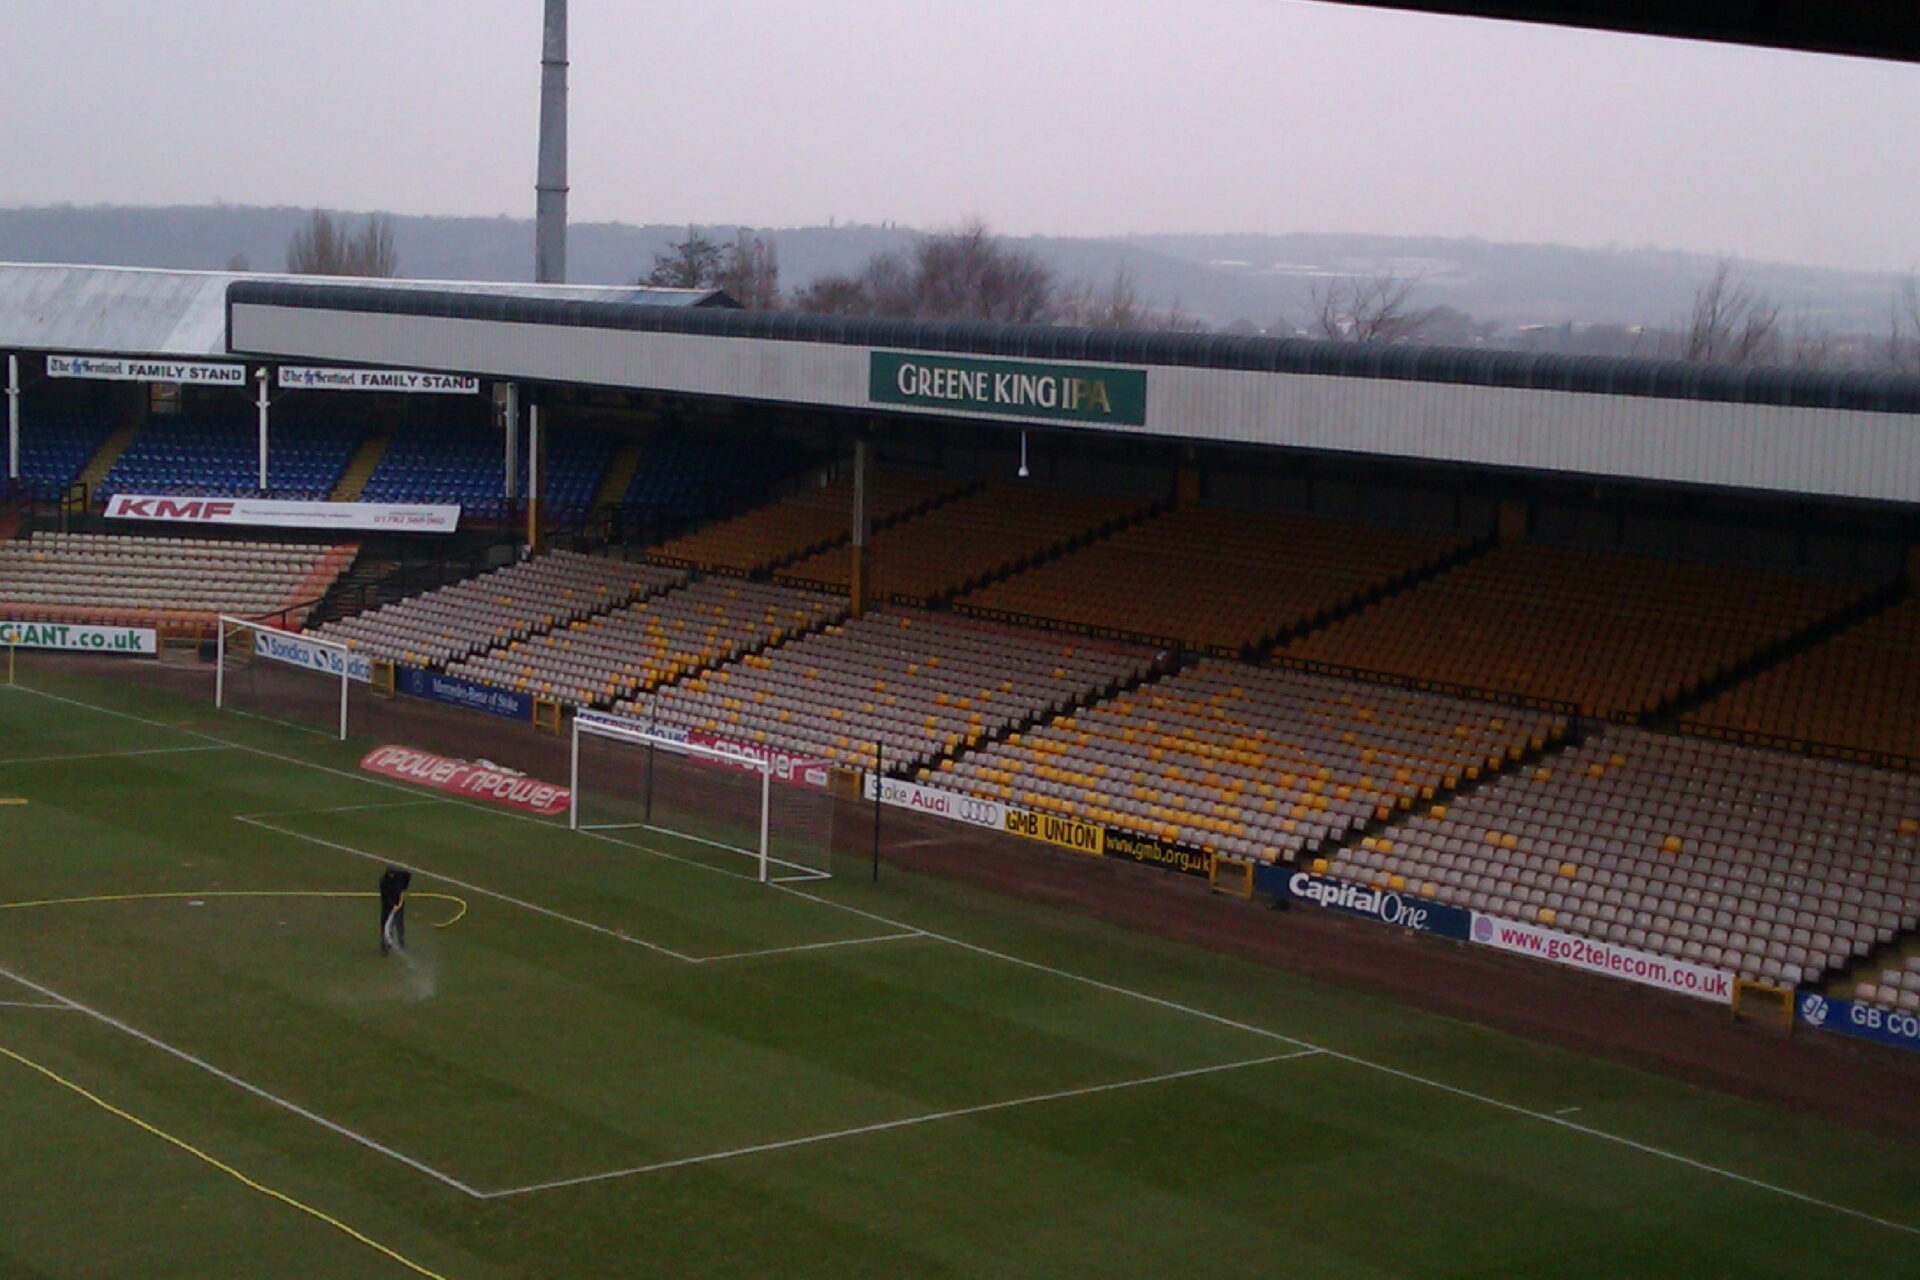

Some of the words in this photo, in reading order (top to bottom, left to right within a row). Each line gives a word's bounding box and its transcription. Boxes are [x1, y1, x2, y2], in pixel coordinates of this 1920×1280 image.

[128, 363, 185, 378] FAMILY
[189, 366, 242, 381] STAND
[361, 373, 418, 388] FAMILY
[422, 376, 475, 390] STAND
[897, 363, 988, 402] GREENE
[994, 372, 1057, 408] KING
[1062, 377, 1112, 414] IPA
[116, 498, 236, 519] KMF
[366, 748, 469, 783] npower
[460, 770, 570, 809] npower
[911, 790, 950, 813] Audi
[1006, 809, 1039, 835] GMB
[1044, 816, 1097, 850] UNION
[1106, 836, 1211, 873] www.gmb.org.uk
[1501, 927, 1729, 997] www.go2telecom.co.uk
[1851, 1005, 1881, 1029] GB
[1887, 1014, 1920, 1039] CO
